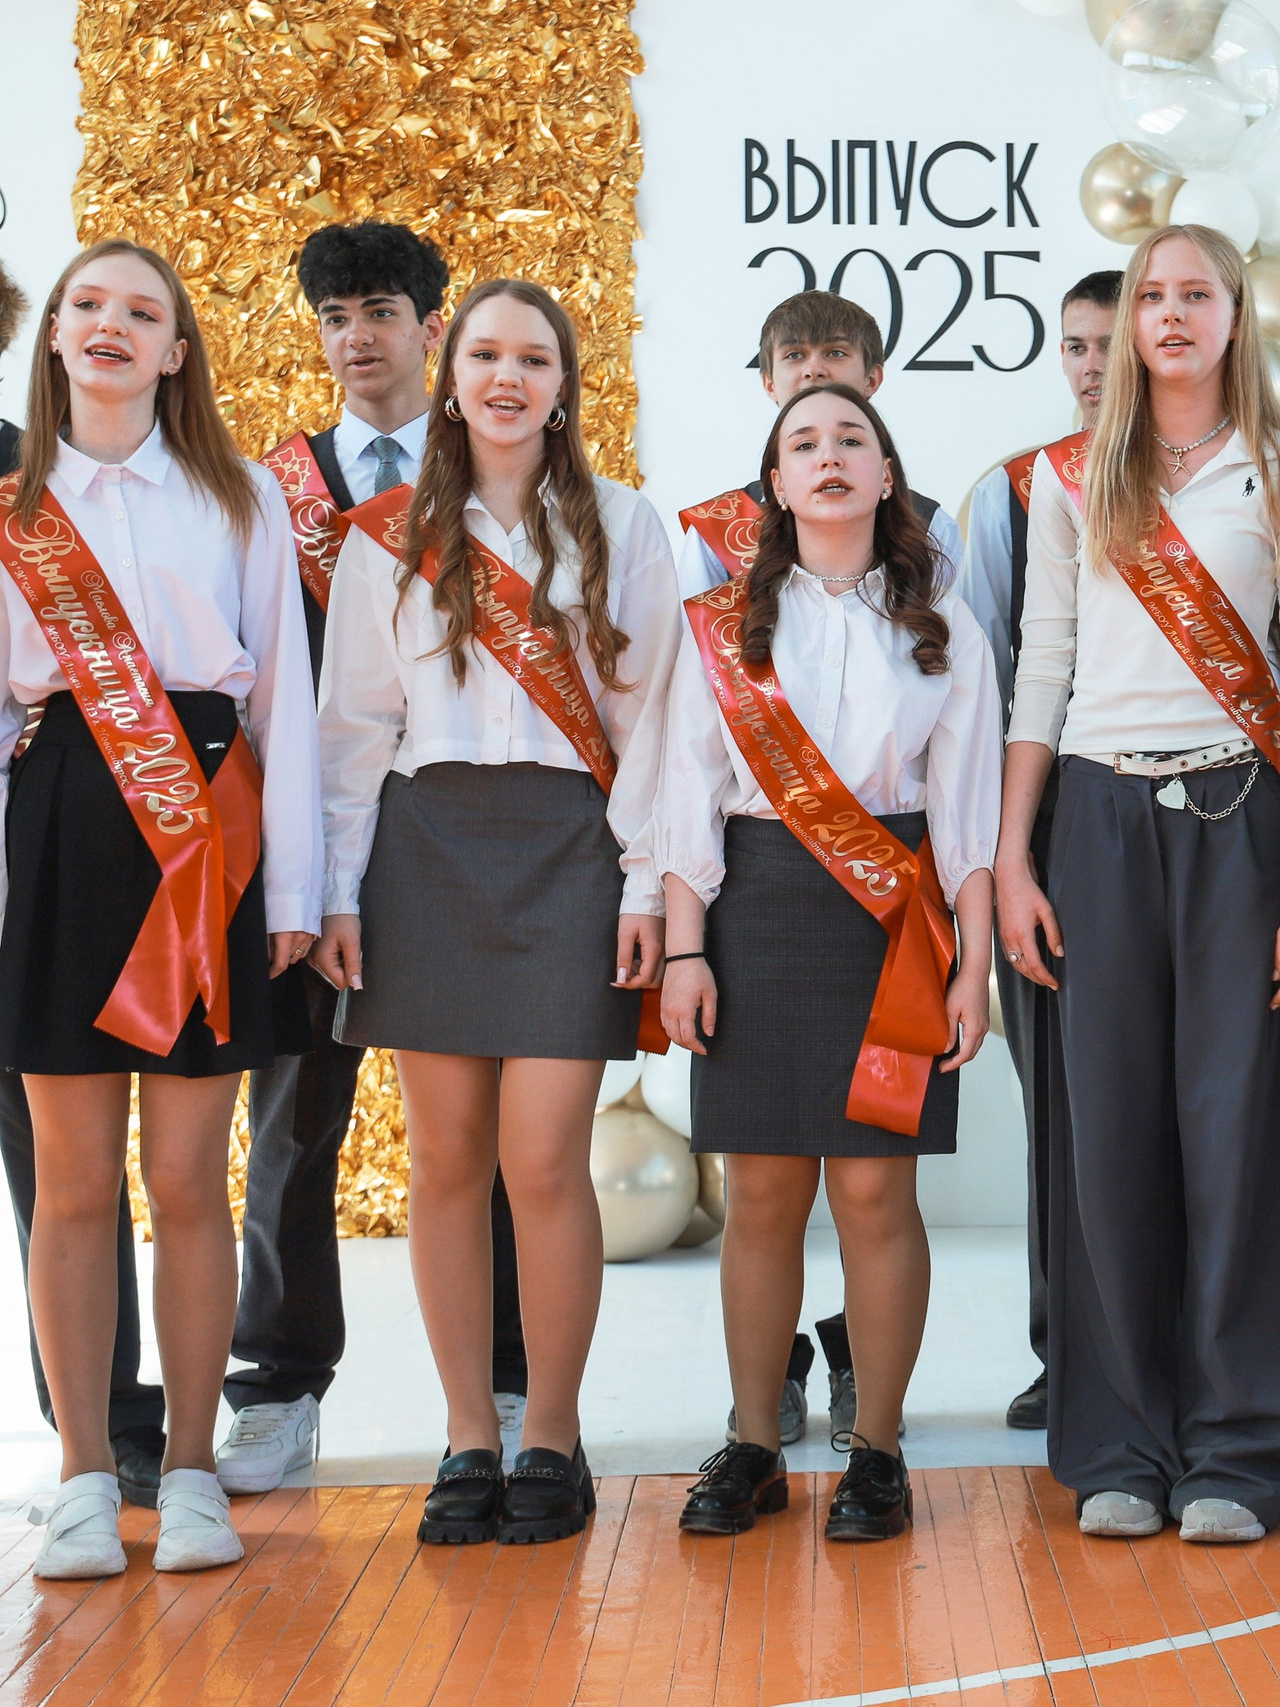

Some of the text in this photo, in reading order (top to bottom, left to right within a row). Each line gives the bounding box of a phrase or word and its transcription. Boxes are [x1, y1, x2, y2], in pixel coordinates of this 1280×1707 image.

[744, 138, 1039, 228] ВЫПУСК
[1138, 518, 1245, 681] ыпускница
[1203, 590, 1252, 657] Екатерина
[4, 508, 214, 835] Выпускница 2025
[46, 625, 71, 658] МБОУ
[112, 631, 155, 708] Анастасия
[500, 652, 530, 678] МБОУ
[1147, 601, 1173, 629] МБОУ
[1166, 630, 1191, 656] Лицей
[1211, 683, 1253, 734] Новосибирск
[798, 745, 830, 791] Алёна
[788, 817, 833, 867] Новосибирск
[809, 810, 917, 896] 2025
